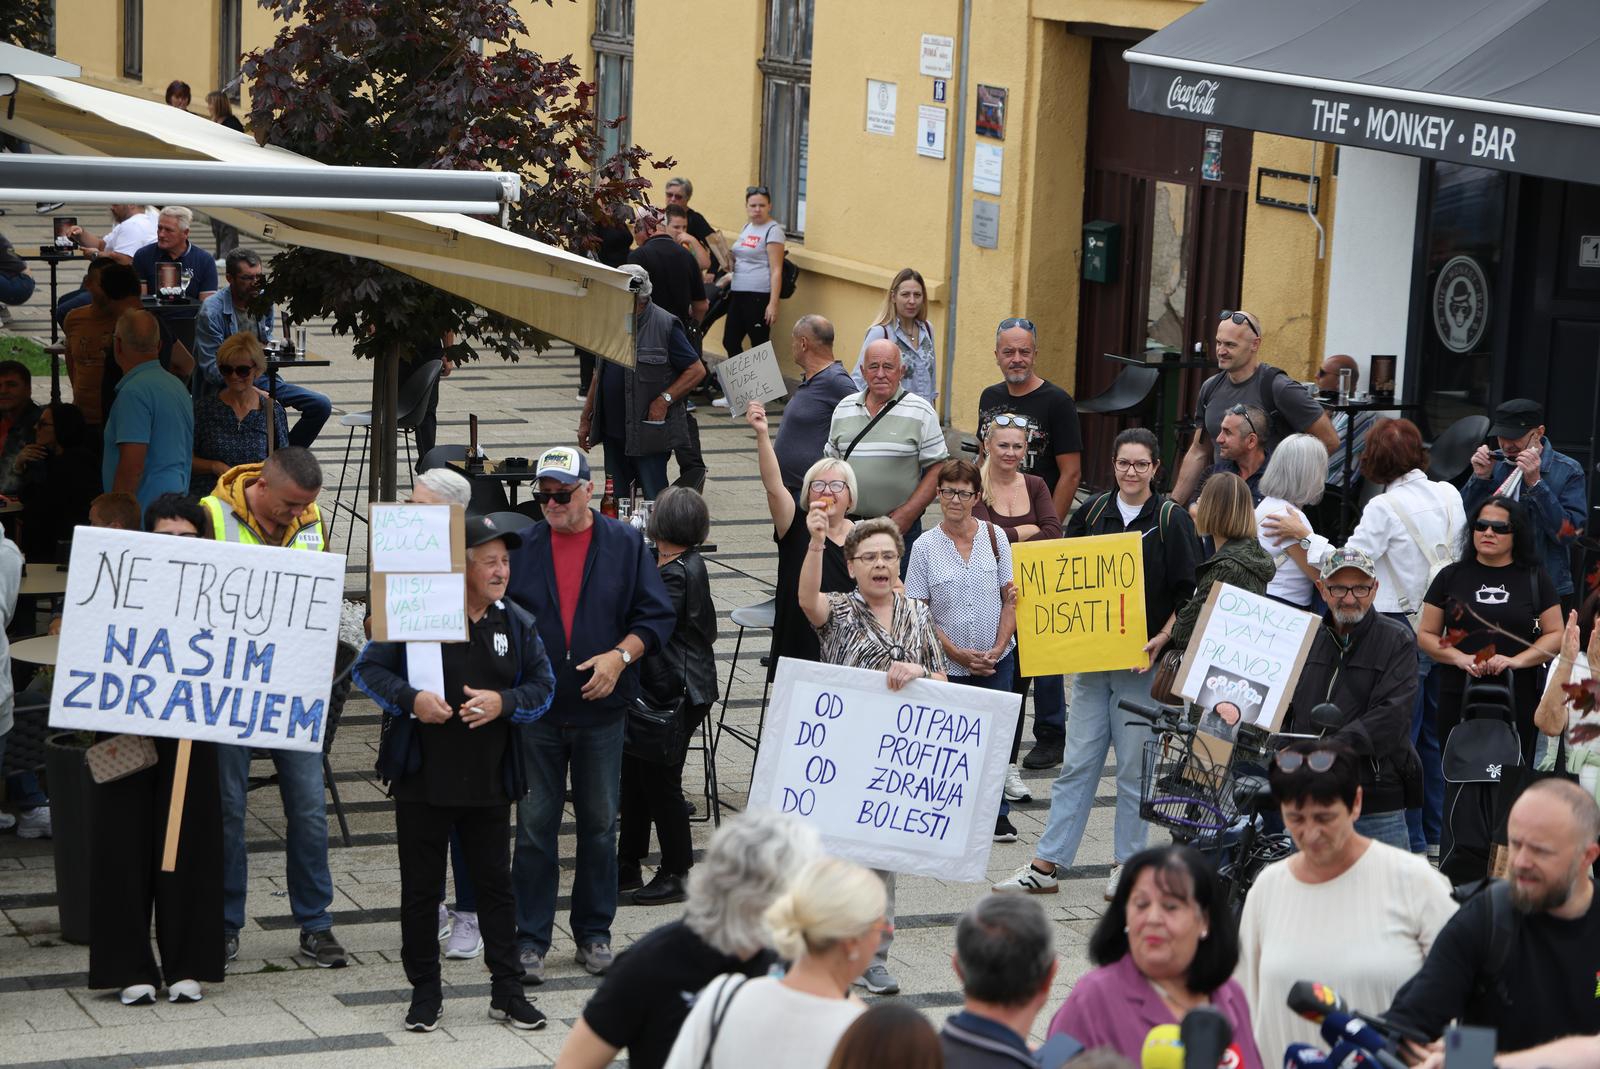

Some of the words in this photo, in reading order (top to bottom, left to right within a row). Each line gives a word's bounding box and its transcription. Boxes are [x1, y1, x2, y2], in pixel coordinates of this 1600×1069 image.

[1167, 76, 1219, 115] Coca-Cola
[1312, 99, 1350, 135] THE
[1365, 106, 1454, 151] MONKEY
[1471, 123, 1516, 162] BAR
[76, 549, 152, 610] NE
[168, 559, 336, 636] TRGUJTE
[1020, 560, 1046, 597] MI
[1055, 552, 1136, 593] ŽELIMO
[1219, 592, 1305, 632] ODAKLE
[1224, 619, 1276, 649] VAM
[103, 623, 276, 684] NAŠIM
[63, 669, 325, 743] ZDRAVLJEM
[815, 692, 844, 719] OD
[897, 703, 981, 748] OTPADA
[794, 721, 826, 748] DO
[877, 734, 969, 781] PROFITA
[805, 755, 836, 784] OD
[866, 767, 964, 811] ZDRAVLJA
[782, 787, 816, 816] DO
[856, 800, 951, 840] BOLESTI
